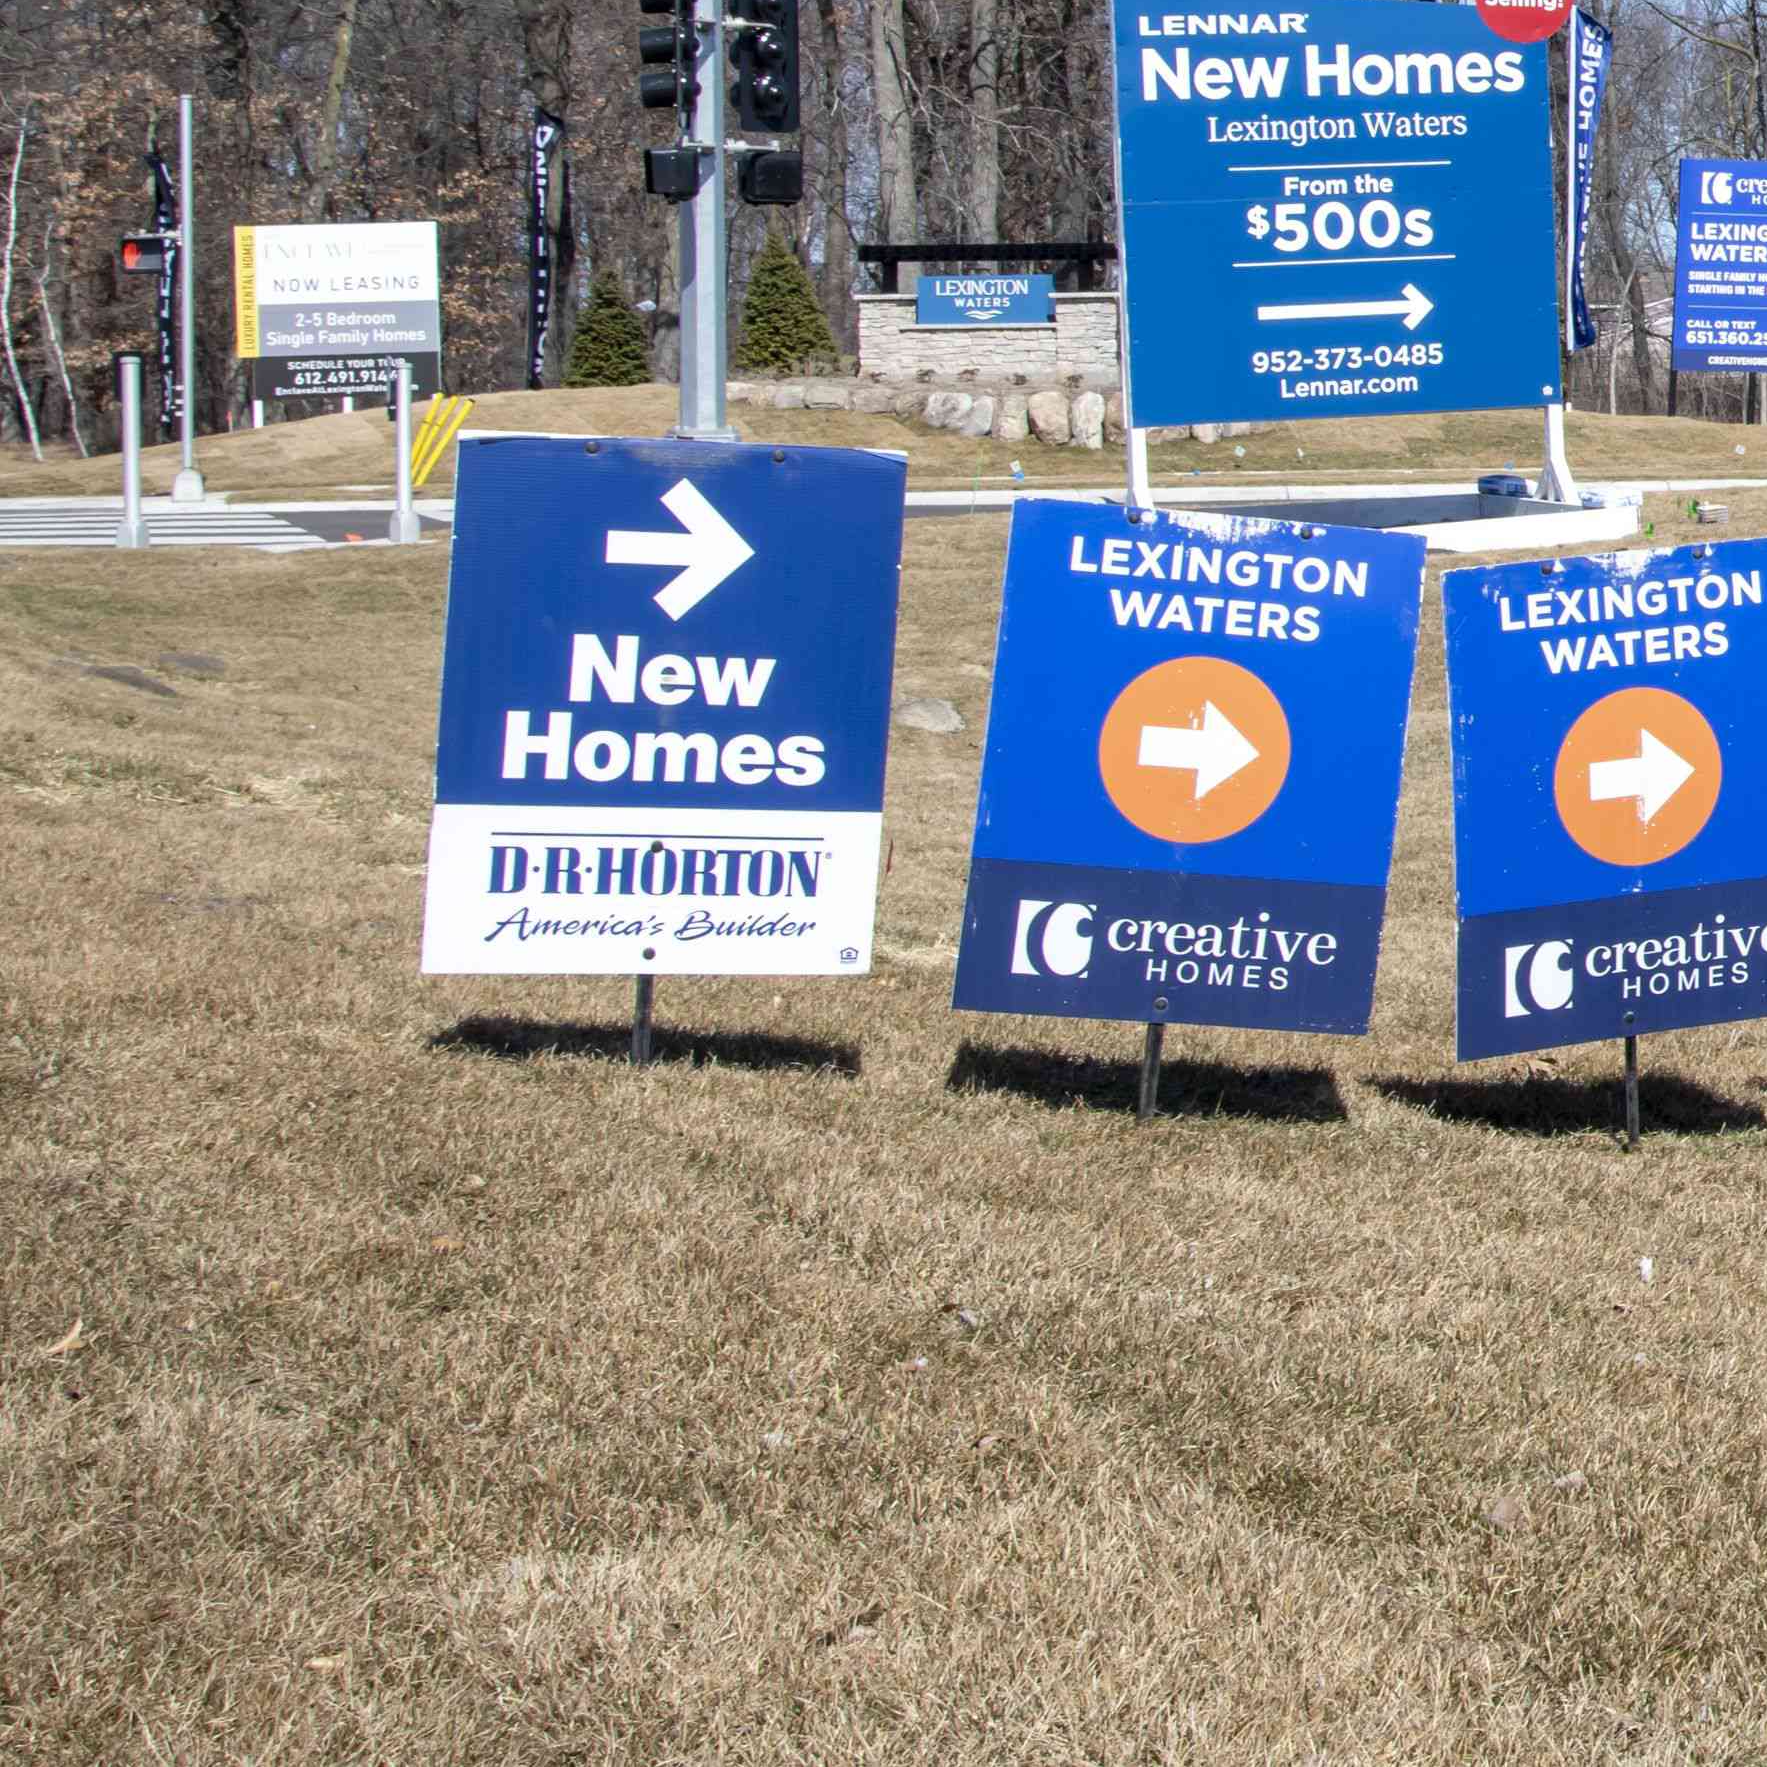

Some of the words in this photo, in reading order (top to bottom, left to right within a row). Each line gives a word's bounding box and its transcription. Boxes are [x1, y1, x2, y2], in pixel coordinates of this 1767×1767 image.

[1138, 14, 1308, 36] LENNAR
[1142, 47, 1289, 101] New
[1306, 44, 1525, 97] Homes
[1208, 116, 1356, 147] Lexington
[1362, 112, 1468, 138] Waters
[1285, 176, 1347, 196] From
[1354, 174, 1393, 193] the
[1247, 199, 1434, 252] $500s
[241, 235, 254, 268] HOMES
[243, 275, 254, 311] RENTAL
[274, 279, 319, 292] NOW
[330, 275, 419, 291] LEASING
[935, 279, 1029, 296] LEXINGTON
[1688, 284, 1734, 294] STARTING
[1735, 286, 1746, 295] IN
[1747, 286, 1765, 295] THE
[1689, 271, 1722, 281] SINGLE
[1724, 272, 1756, 282] FAMILY
[954, 298, 1010, 307] WATERS
[243, 315, 255, 350] LUXURY
[295, 313, 322, 327] 2-5
[327, 312, 396, 325] Bedroom
[1686, 320, 1712, 328] CALL
[1714, 321, 1729, 329] OR
[1731, 321, 1756, 329] TEXT
[266, 332, 314, 348] Single
[319, 331, 369, 345] Family
[374, 329, 426, 341] Homes
[287, 360, 344, 370] SCHEDULE
[347, 360, 375, 369] YOUR
[1252, 344, 1443, 374] 952-373-0485
[1281, 376, 1418, 400] Lennar.com
[1070, 536, 1368, 597] LEXINGTON
[1110, 589, 1320, 642] WATERS
[1500, 571, 1761, 631] LEXINGTON
[1540, 622, 1729, 674] WATERS
[568, 634, 776, 707] New
[502, 711, 826, 786] Homes
[484, 907, 664, 943] America's
[674, 909, 816, 942] Builder
[1107, 911, 1337, 965] creative
[1145, 959, 1289, 990] HOMES
[1622, 961, 1749, 999] HOMES
